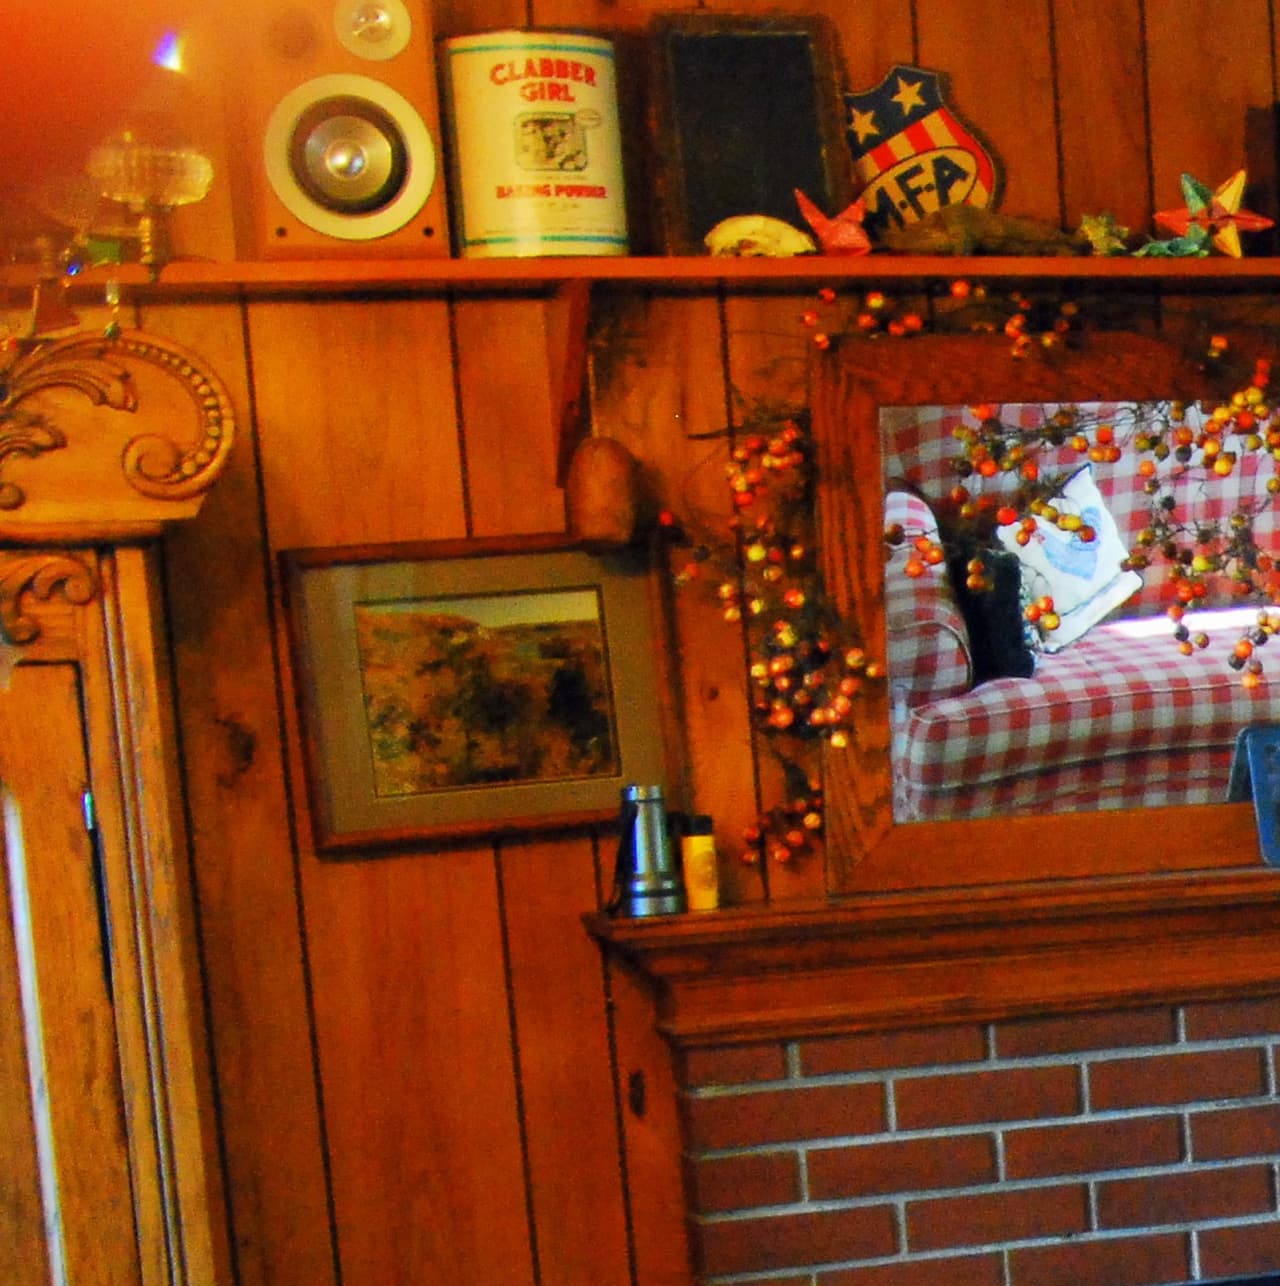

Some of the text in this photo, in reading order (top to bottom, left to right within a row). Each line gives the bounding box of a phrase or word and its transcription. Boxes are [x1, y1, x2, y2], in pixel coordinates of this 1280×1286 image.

[490, 57, 597, 88] CLABBER
[520, 82, 576, 102] GIRL
[496, 184, 608, 199] BAING POWDER
